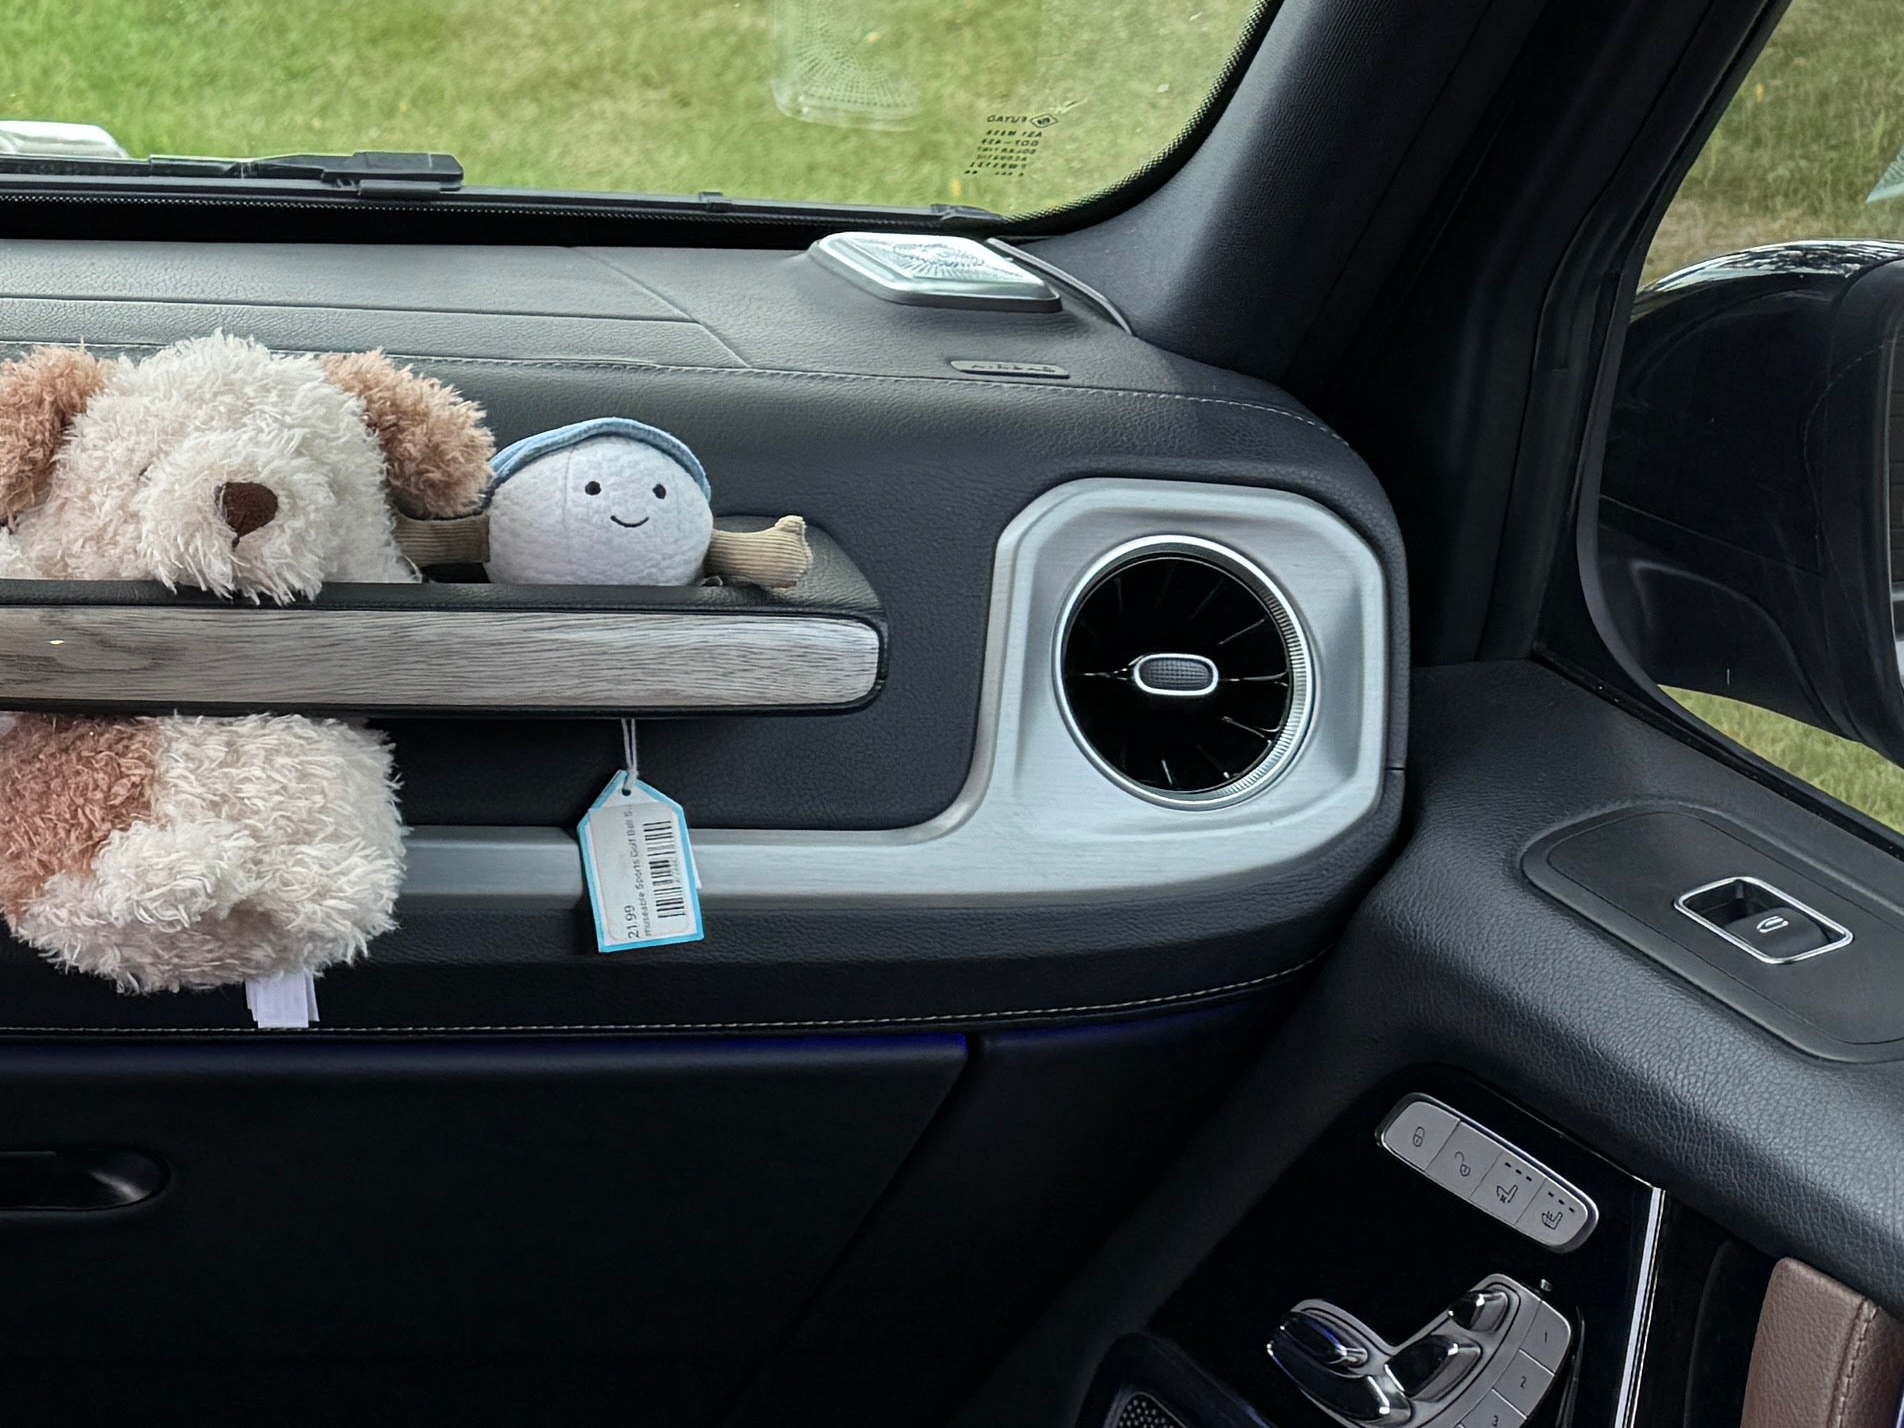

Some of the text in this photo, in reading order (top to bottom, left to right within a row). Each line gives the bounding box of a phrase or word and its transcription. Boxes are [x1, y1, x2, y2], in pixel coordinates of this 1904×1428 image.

[633, 858, 644, 890] Sports
[624, 905, 640, 939] 21.99
[1519, 1375, 1528, 1389] 2
[1491, 1414, 1499, 1428] 3
